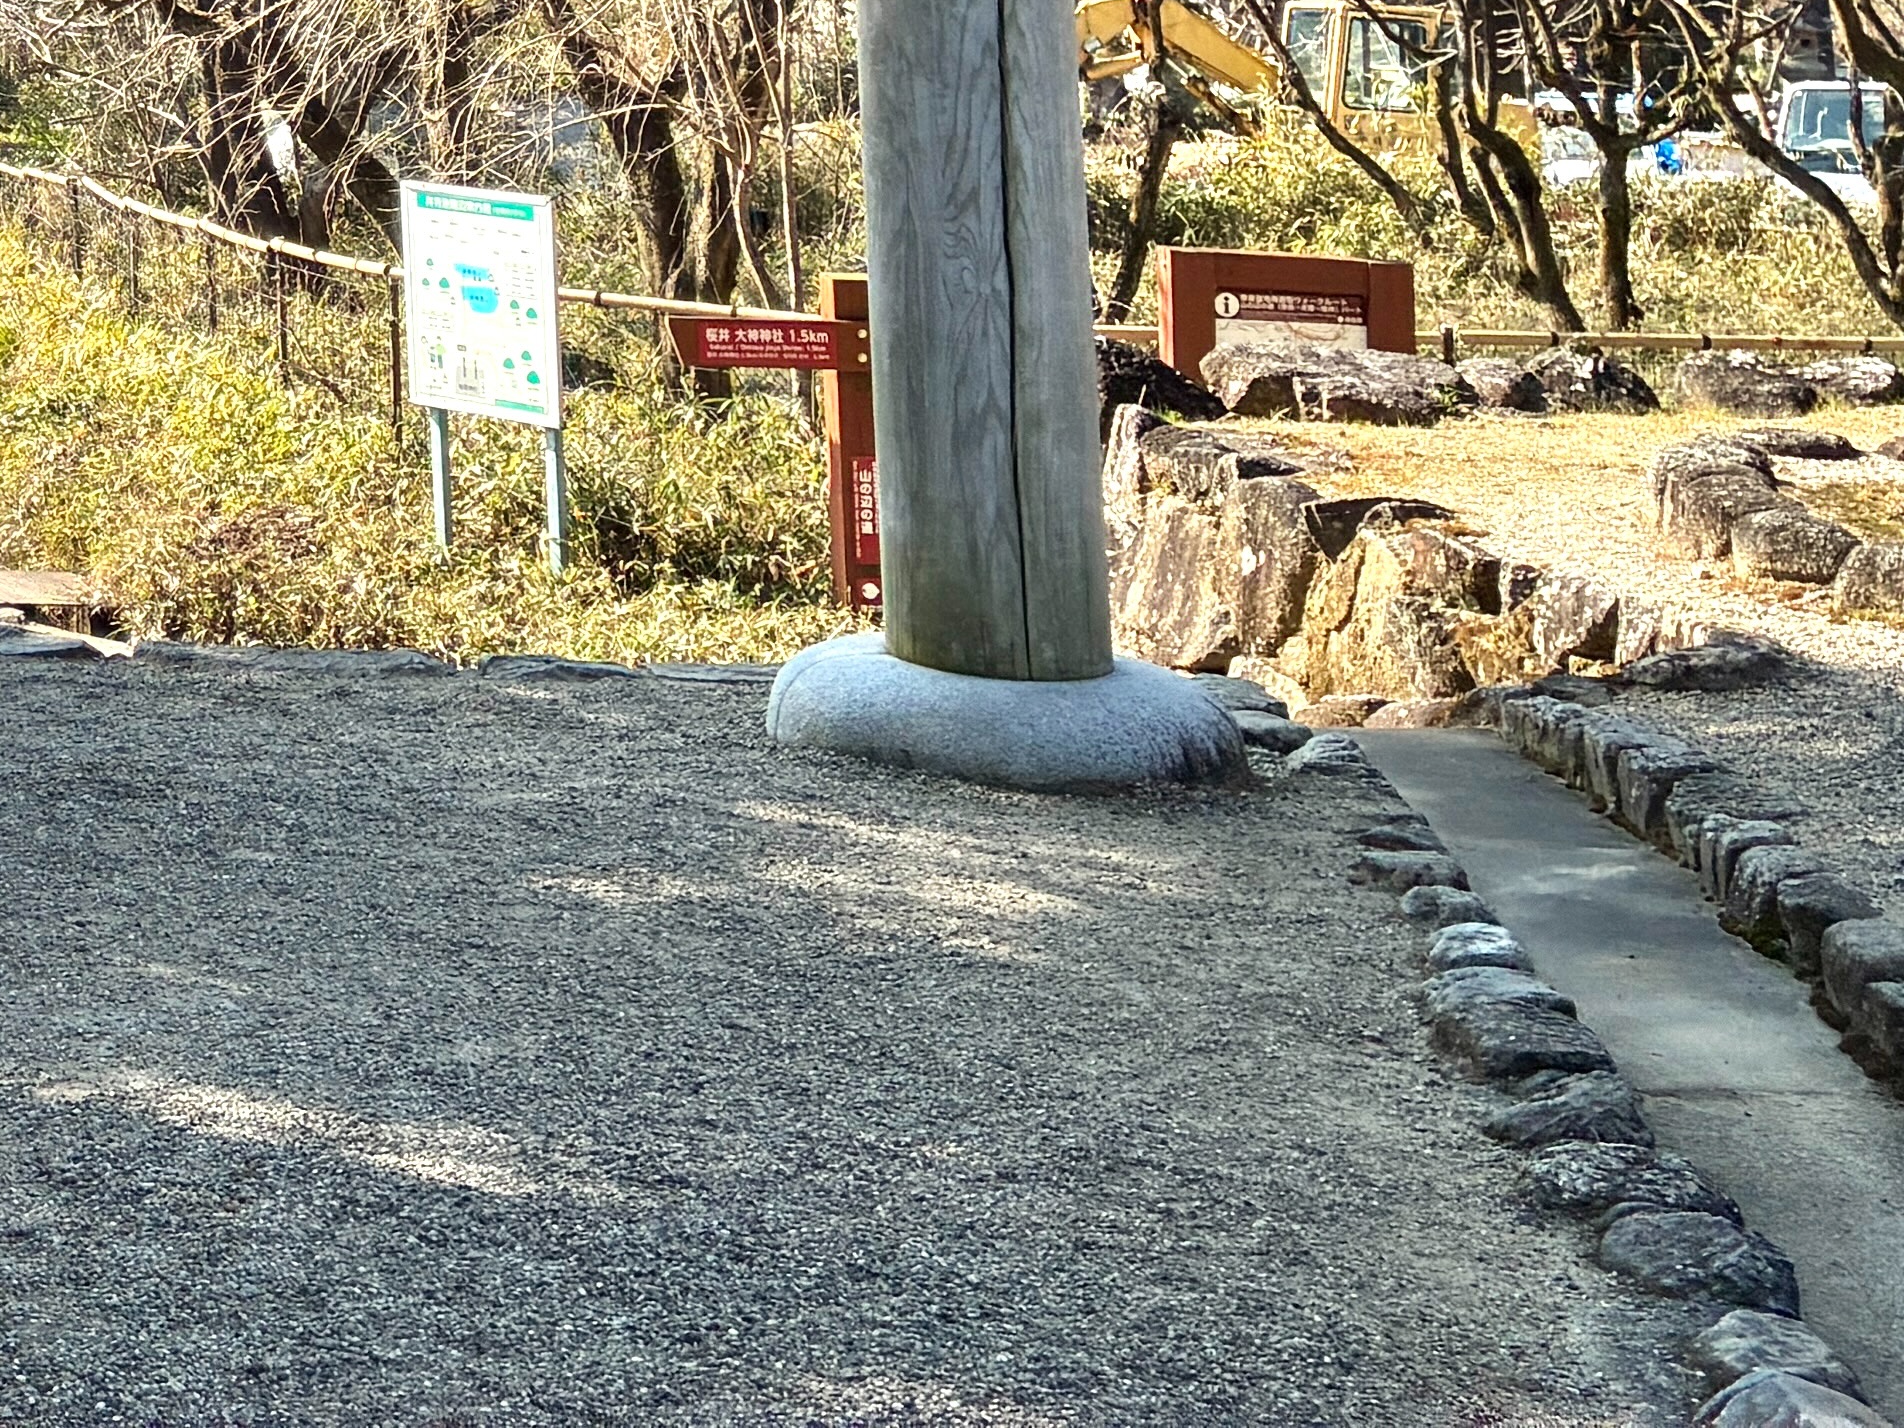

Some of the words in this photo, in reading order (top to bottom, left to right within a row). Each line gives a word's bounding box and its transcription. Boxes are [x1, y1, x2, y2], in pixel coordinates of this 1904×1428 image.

[705, 328, 730, 342] 桜井
[735, 328, 784, 343] 大神神社
[789, 329, 829, 343] 1.5km
[859, 469, 874, 534] 山の辺の
